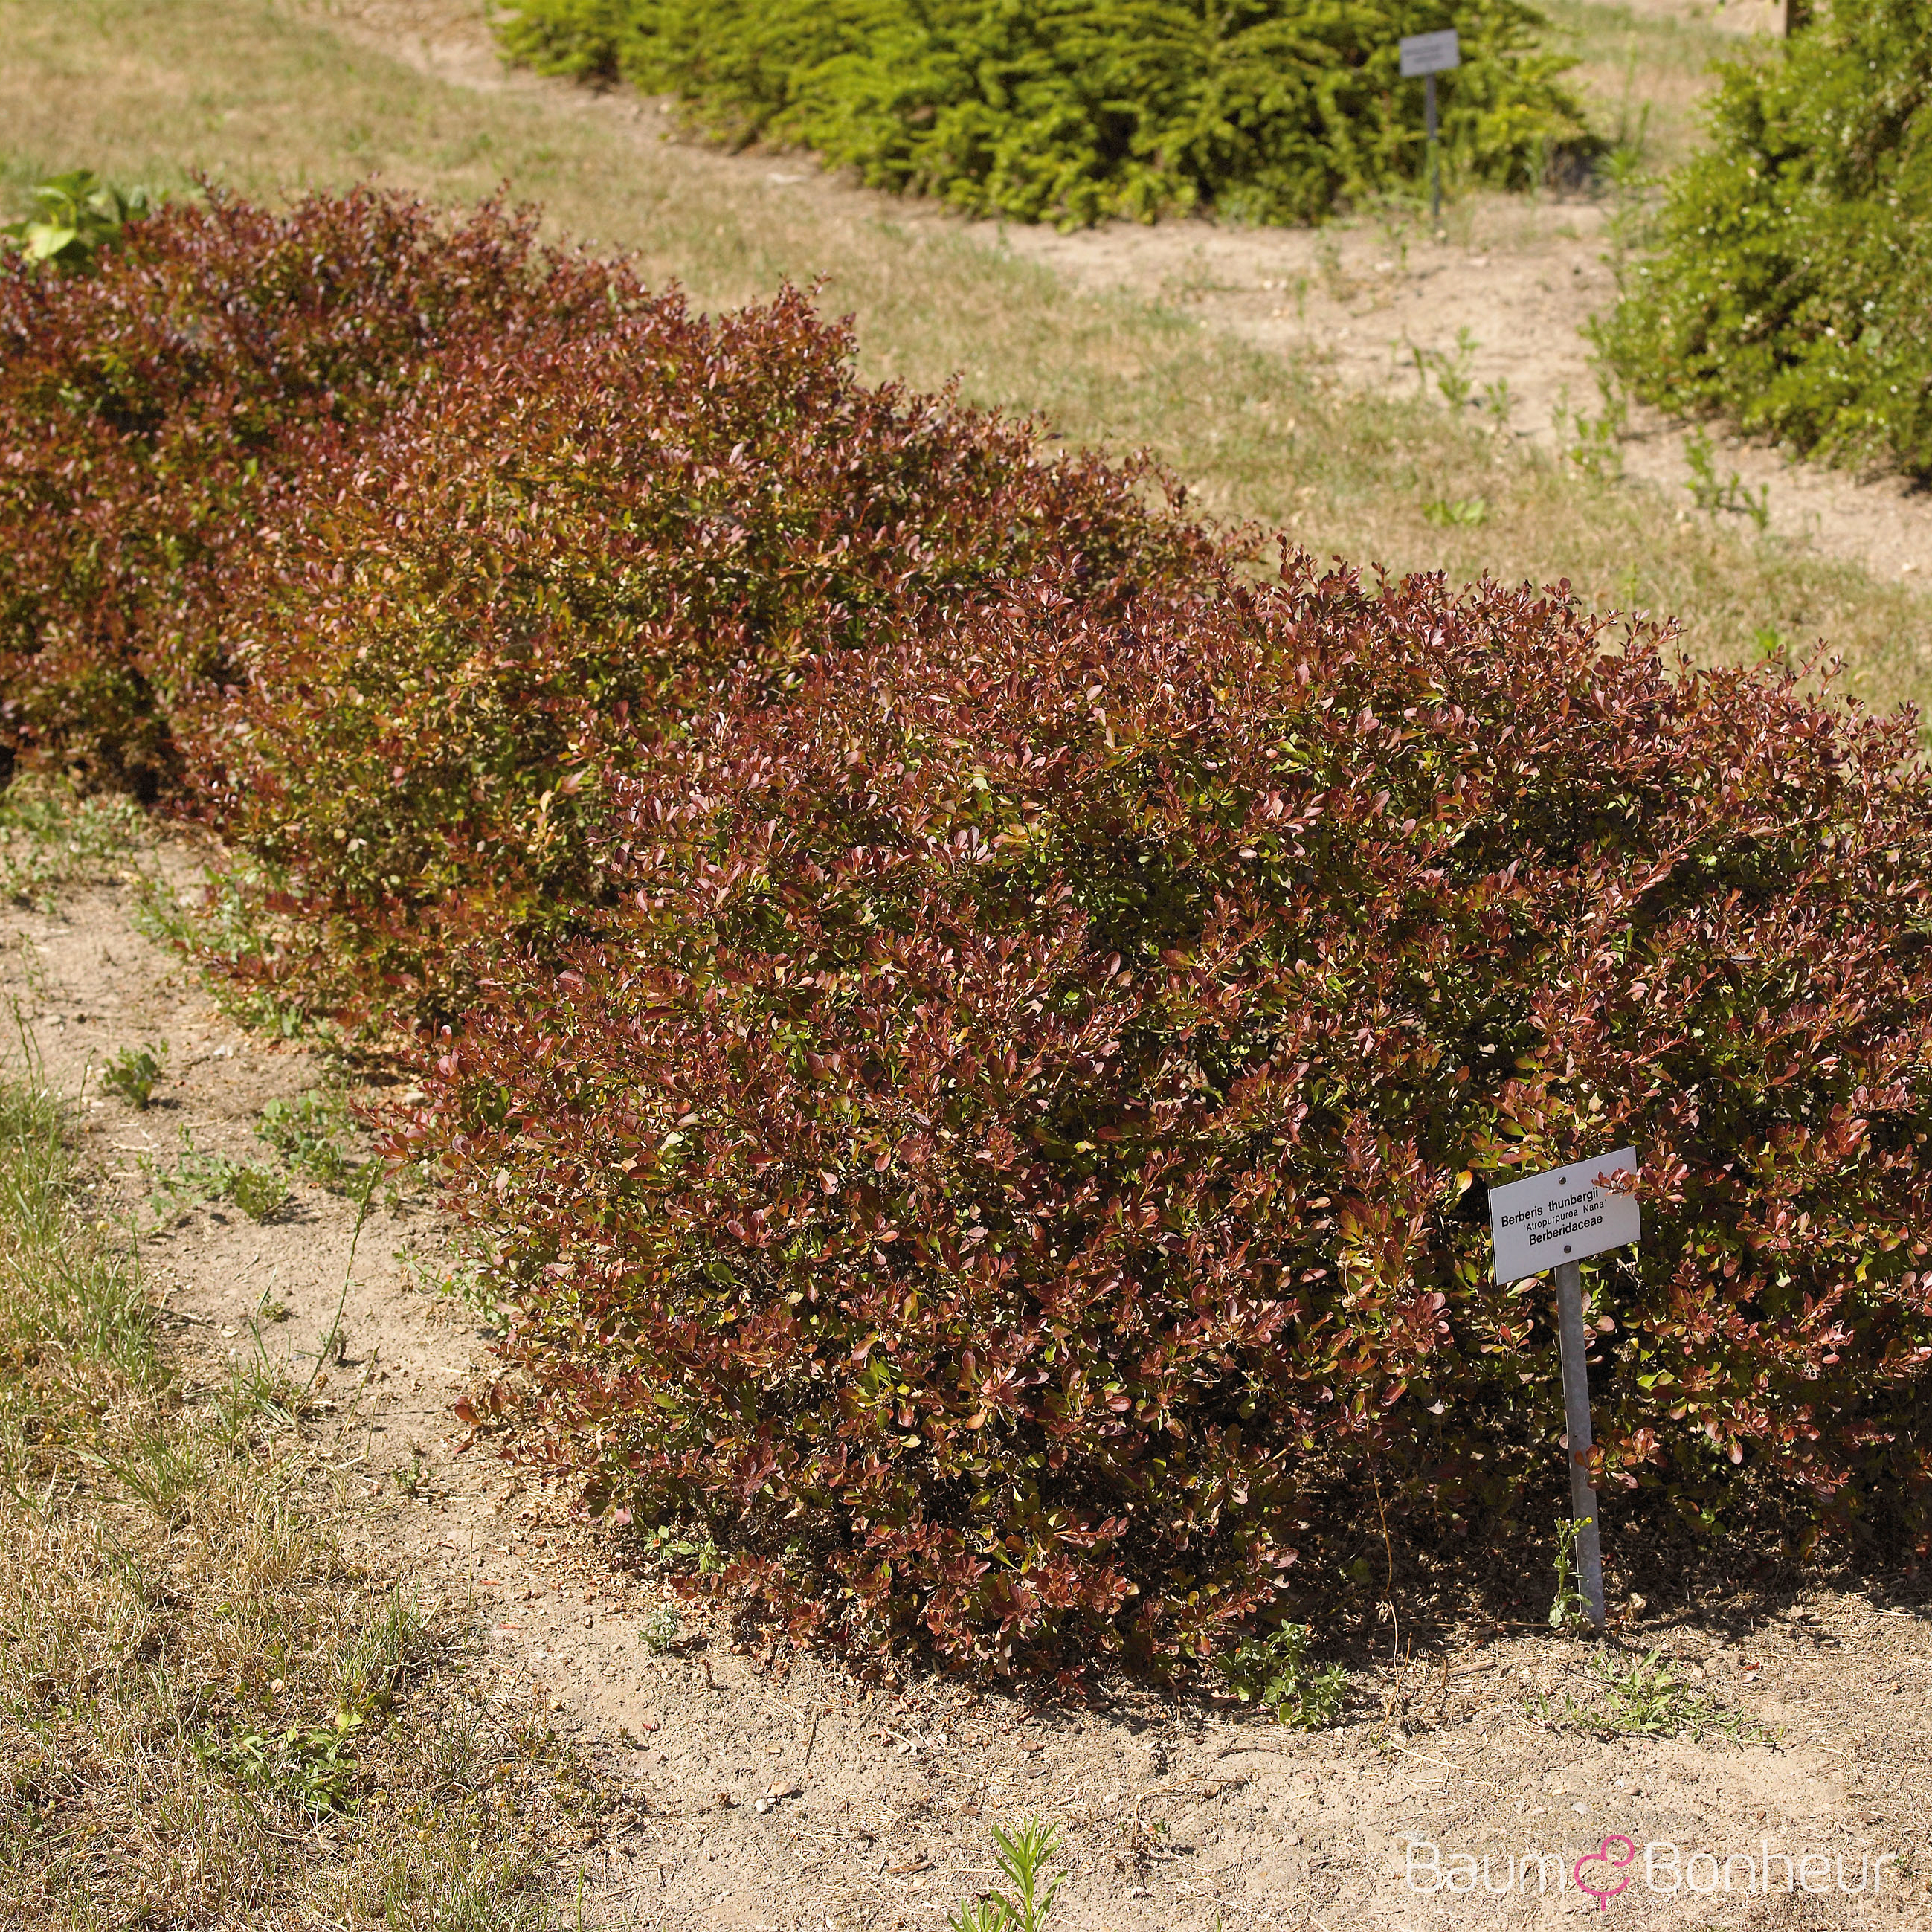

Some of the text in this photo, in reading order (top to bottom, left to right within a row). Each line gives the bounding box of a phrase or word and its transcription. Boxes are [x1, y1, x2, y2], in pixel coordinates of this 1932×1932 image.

[1501, 1187, 1598, 1227] Berberis thunbergii
[1529, 1215, 1603, 1246] Berberidaceae
